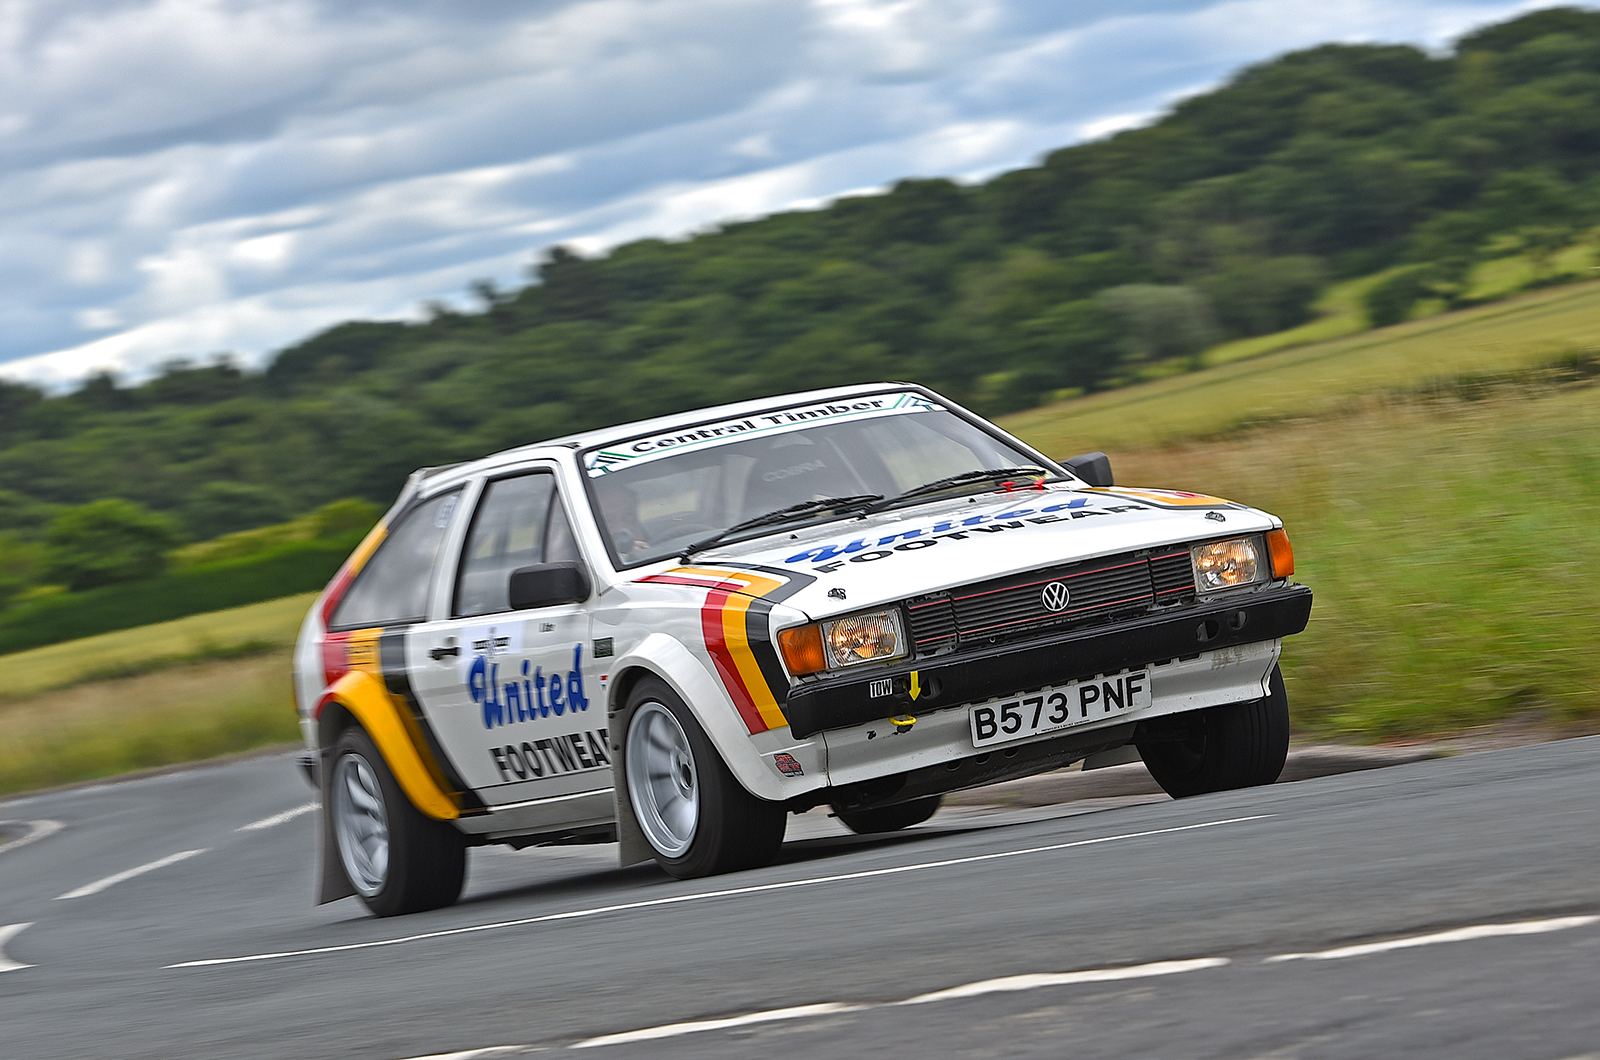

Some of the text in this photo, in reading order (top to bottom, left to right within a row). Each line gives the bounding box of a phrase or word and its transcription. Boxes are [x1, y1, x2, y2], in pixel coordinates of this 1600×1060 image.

[631, 399, 884, 453] Central Timber
[785, 498, 1094, 563] United
[812, 505, 1151, 573] FOOTWEAR
[469, 643, 590, 729] United
[871, 680, 891, 697] TOW
[974, 673, 1146, 740] B573 PNF
